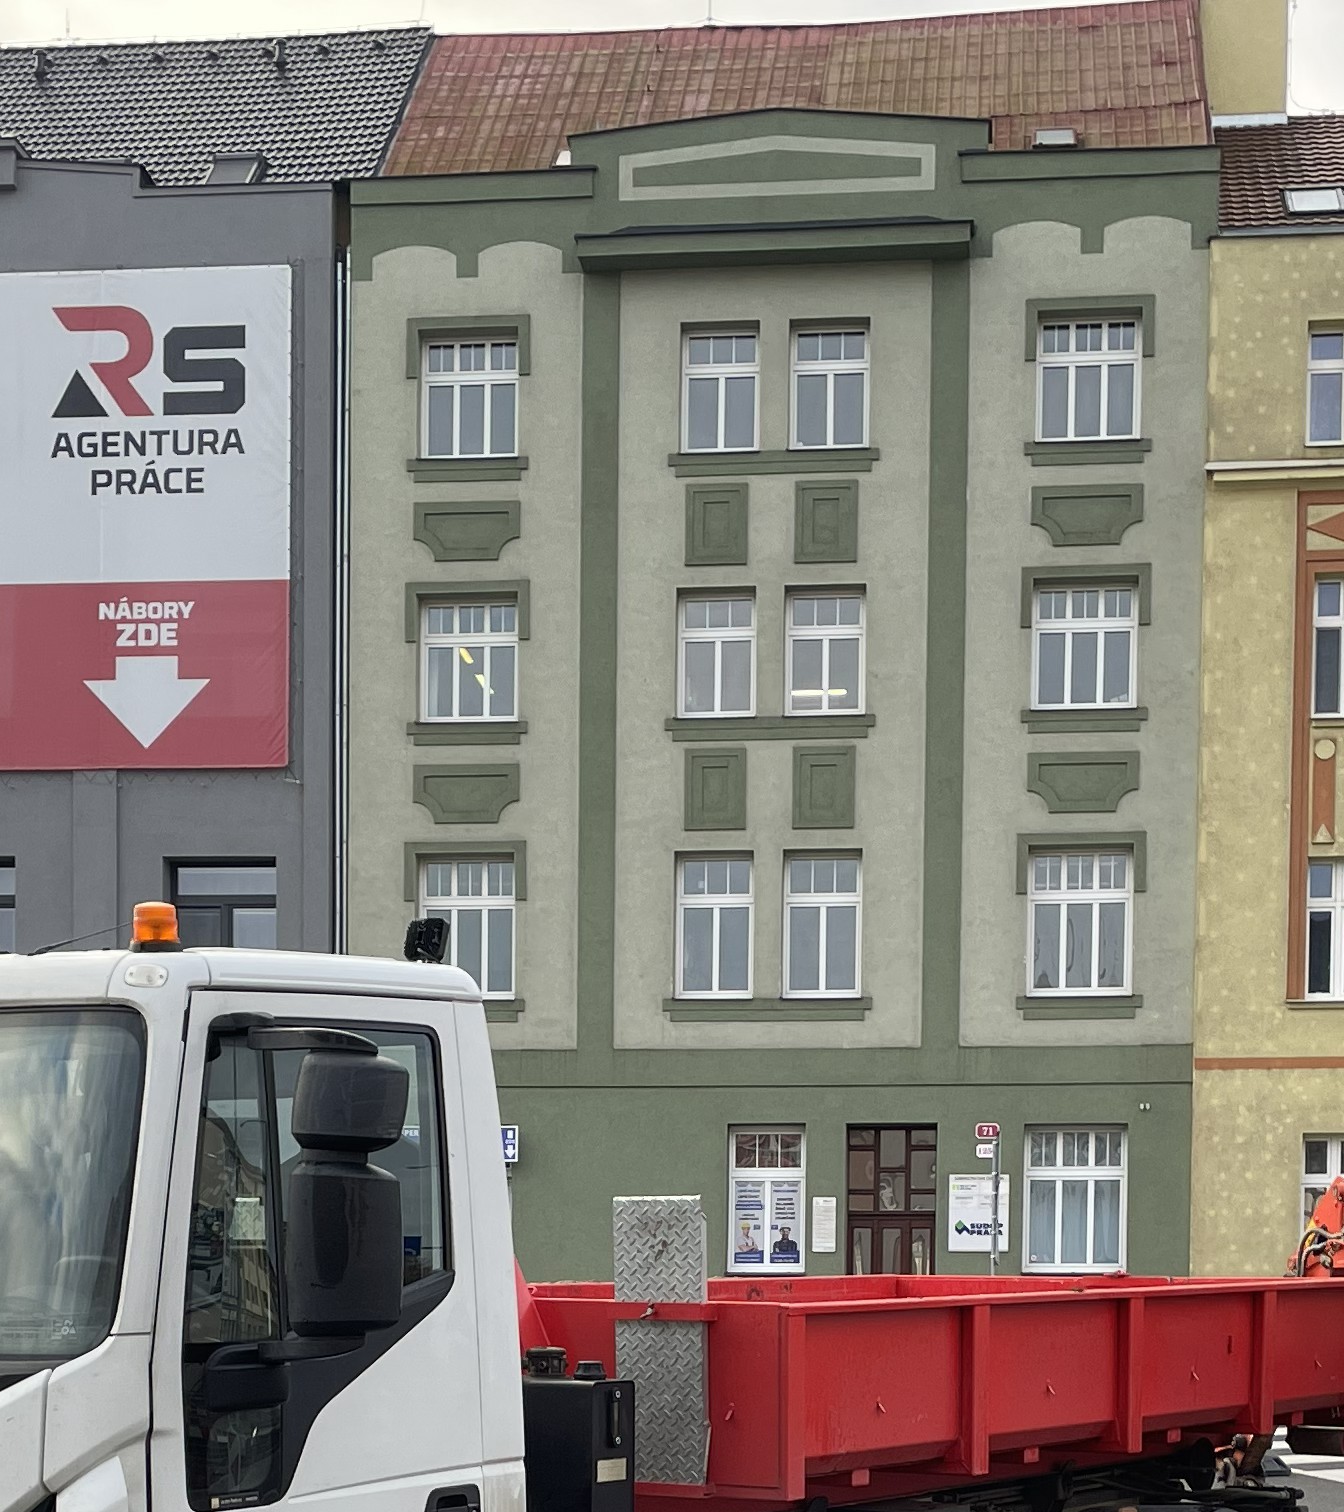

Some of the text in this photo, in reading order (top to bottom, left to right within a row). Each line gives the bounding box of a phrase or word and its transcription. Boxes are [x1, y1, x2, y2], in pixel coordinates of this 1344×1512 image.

[51, 305, 246, 418] RS
[51, 428, 245, 458] AGENTURA
[91, 460, 205, 495] PRÁCE
[98, 597, 195, 620] NÁBORY
[116, 623, 178, 647] ZDE
[982, 1127, 993, 1136] 71
